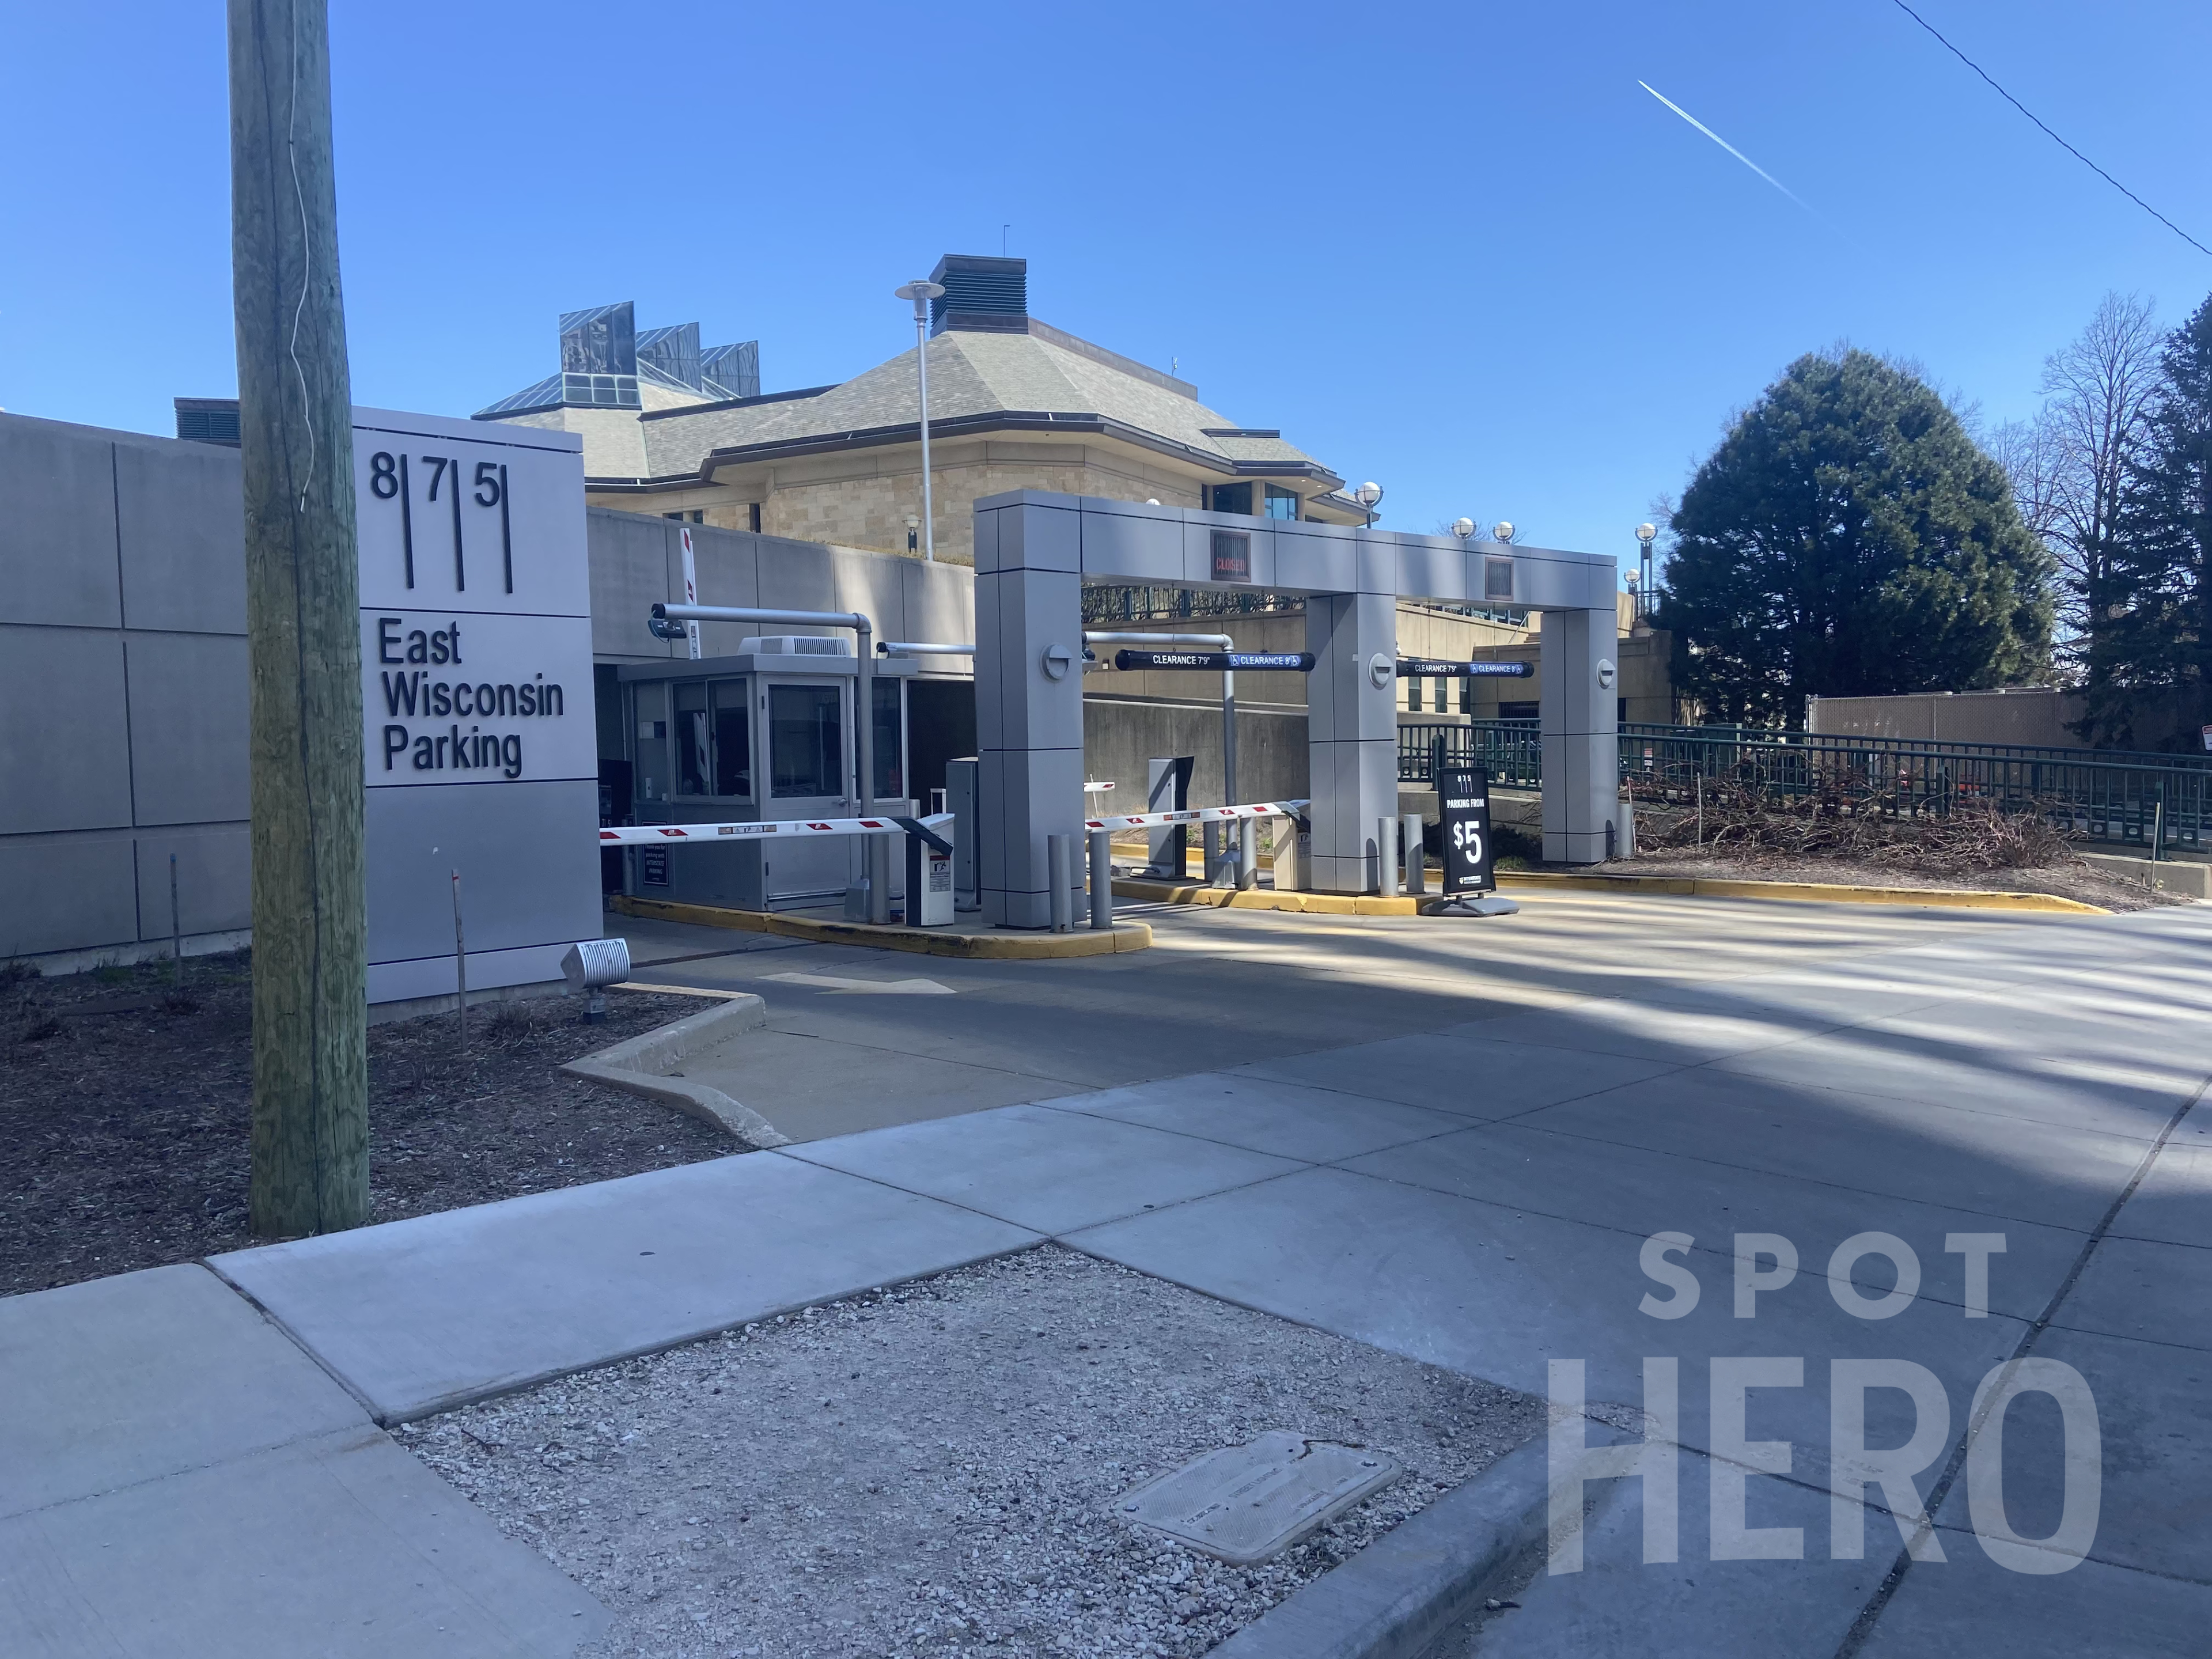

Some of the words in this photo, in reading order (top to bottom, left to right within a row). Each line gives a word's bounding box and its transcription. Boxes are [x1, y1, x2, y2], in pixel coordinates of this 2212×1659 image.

[1216, 557, 1247, 572] CLOSED
[380, 618, 461, 664] East
[1153, 654, 1196, 665] CLEARANCE
[1240, 656, 1283, 665] CLEARANCE
[1415, 664, 1446, 673] CLEARANCE
[1479, 665, 1510, 673] CLEARANCE
[382, 671, 563, 717] Wisconsin
[384, 724, 522, 779] Parking
[1446, 799, 1469, 808] PARKING
[1471, 798, 1484, 808] FROM
[1453, 821, 1482, 863] $5
[1228, 1482, 1256, 1498] STREET
